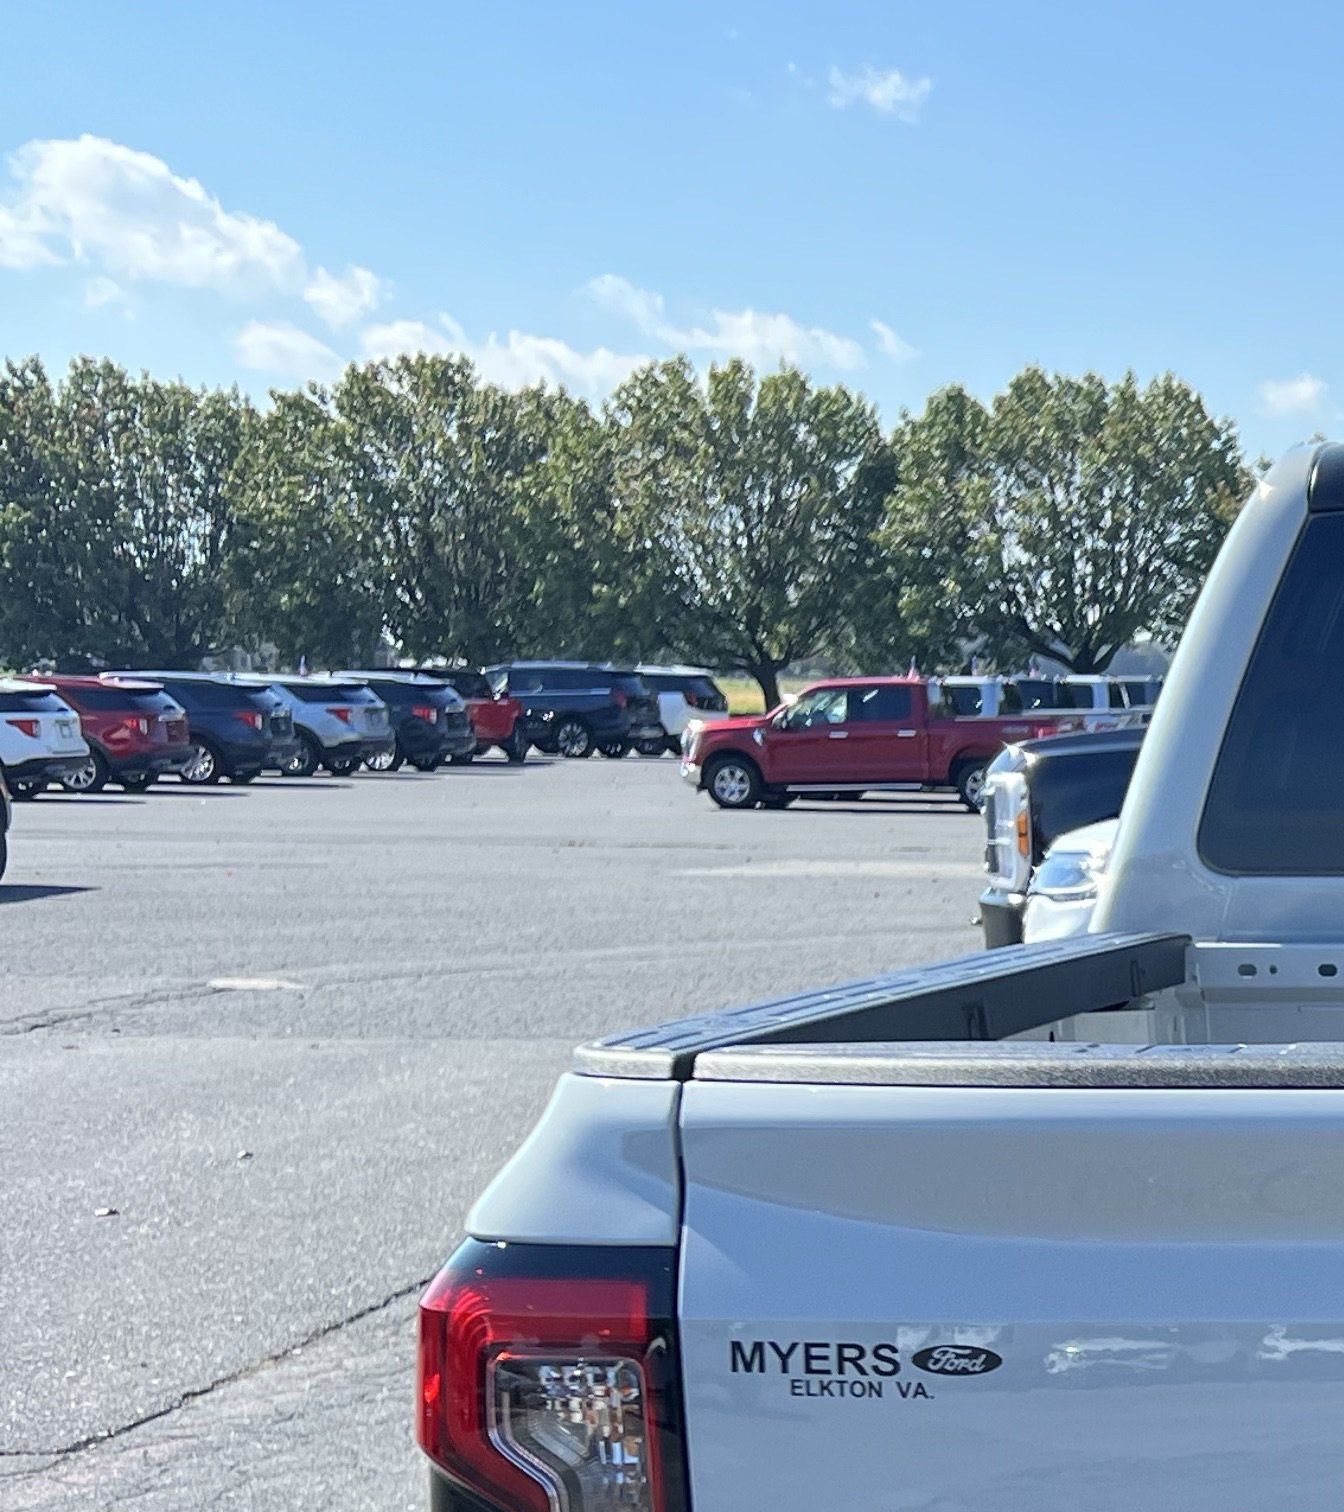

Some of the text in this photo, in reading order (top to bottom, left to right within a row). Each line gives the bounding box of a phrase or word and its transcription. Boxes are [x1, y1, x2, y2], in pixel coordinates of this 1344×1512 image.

[729, 1340, 987, 1377] MYERS Ford
[790, 1378, 936, 1400] ELKTON VA.
